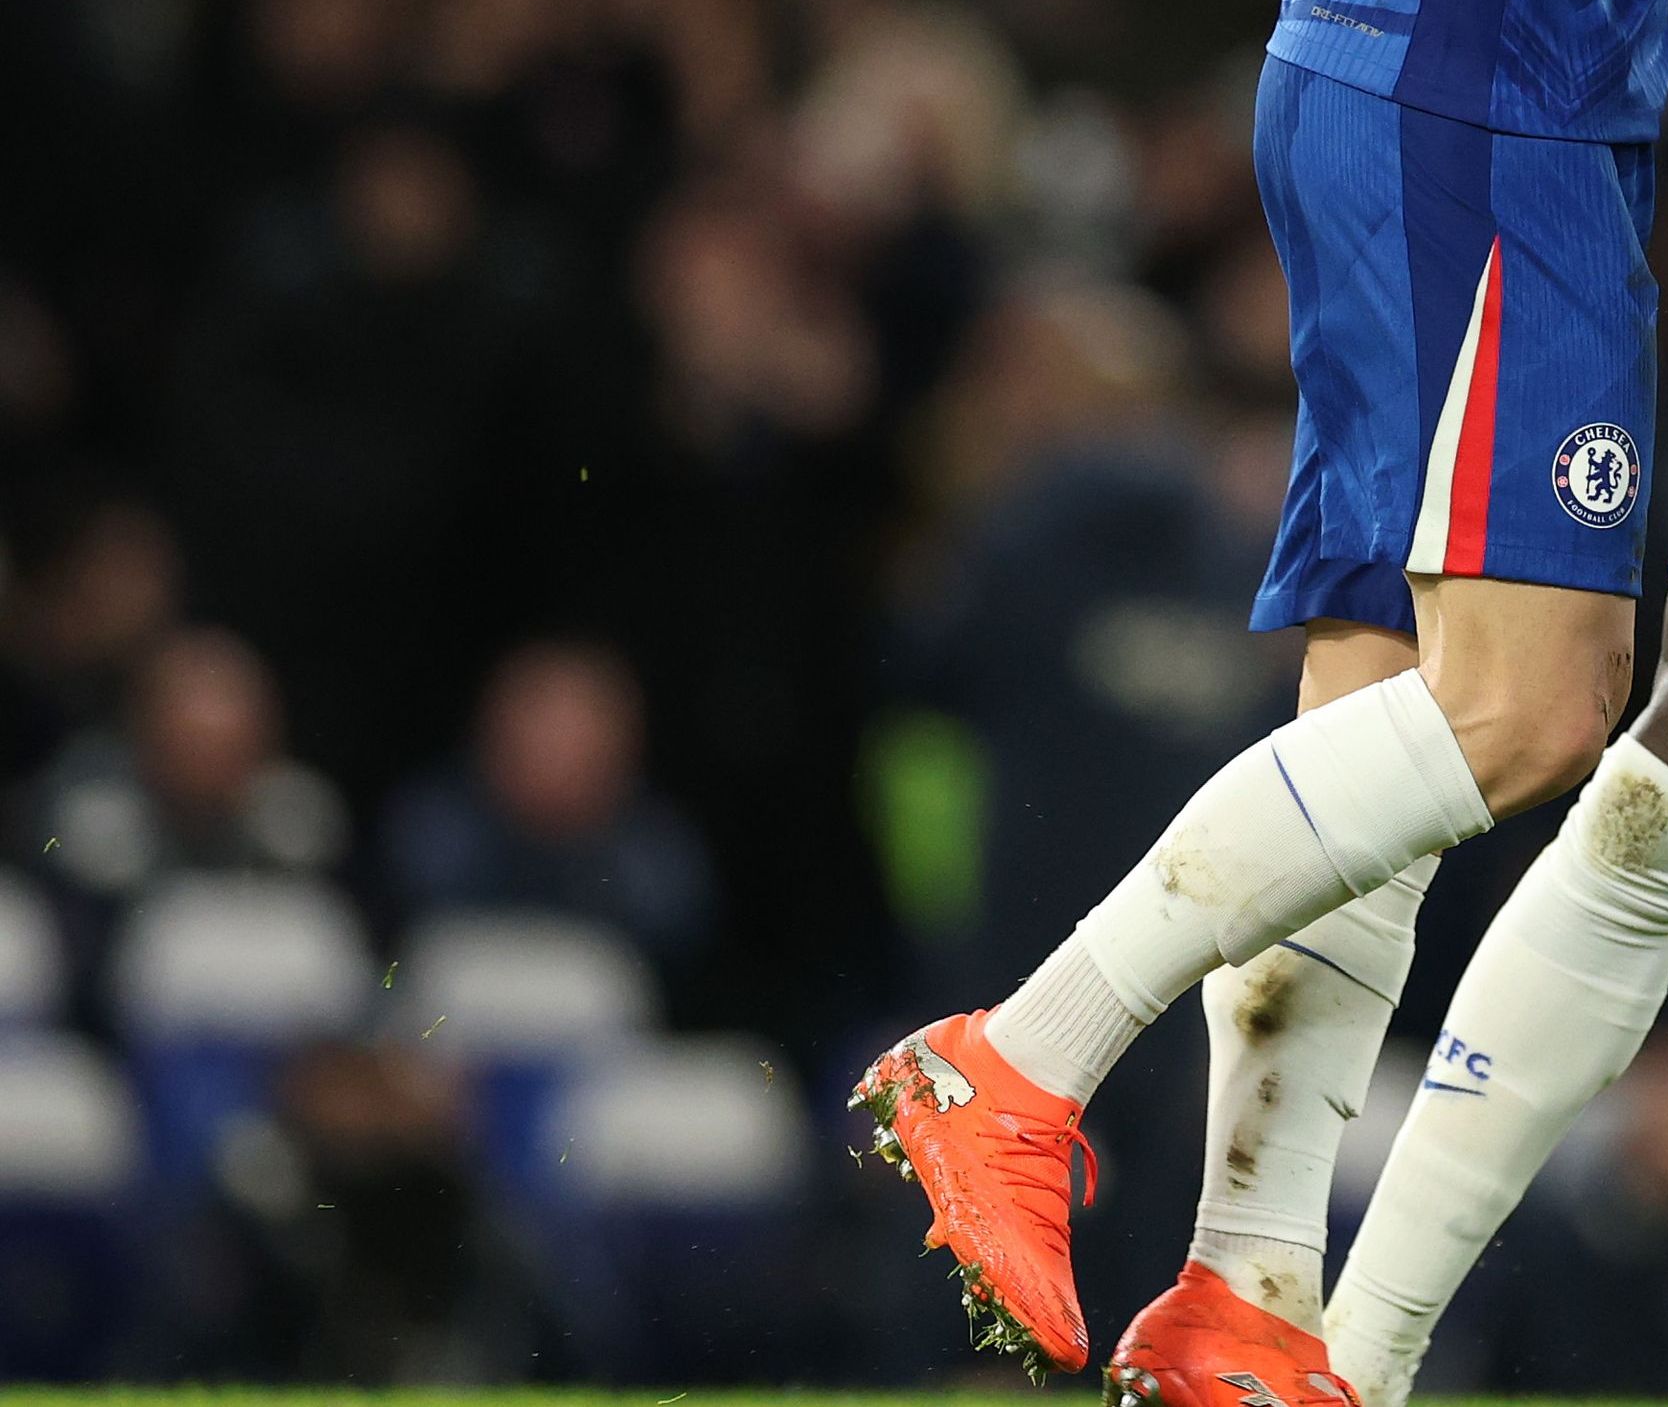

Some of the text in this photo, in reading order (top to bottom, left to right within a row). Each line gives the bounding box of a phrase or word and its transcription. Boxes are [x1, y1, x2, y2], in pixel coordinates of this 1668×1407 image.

[1574, 426, 1632, 454] CHELSEA
[1567, 499, 1626, 523] FOOTBALL CLUB
